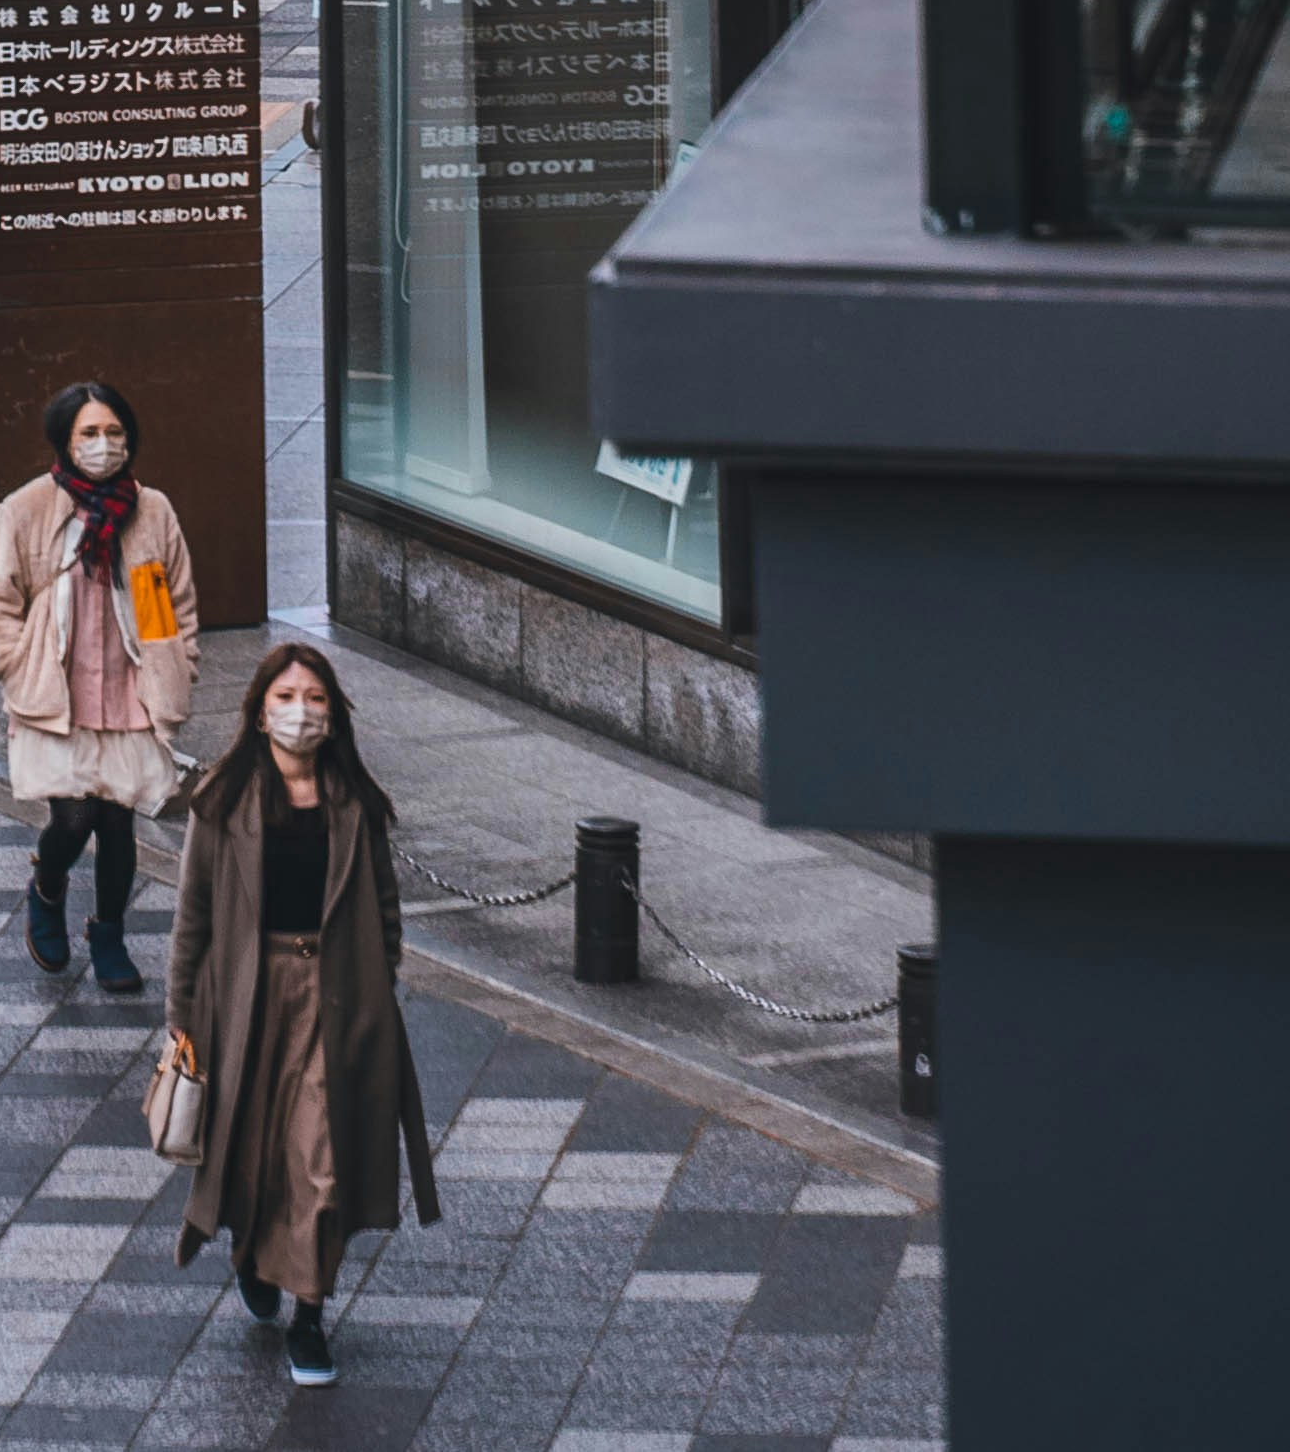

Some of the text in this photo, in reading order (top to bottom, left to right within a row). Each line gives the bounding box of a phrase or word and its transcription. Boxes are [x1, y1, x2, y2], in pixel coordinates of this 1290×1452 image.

[0, 104, 247, 131] BCG BOSTON CONSULTING GROUP
[0, 133, 248, 166] 明治安田のほけんショップ 四条烏丸西
[77, 174, 165, 194] KYOTO
[183, 171, 249, 188] LION
